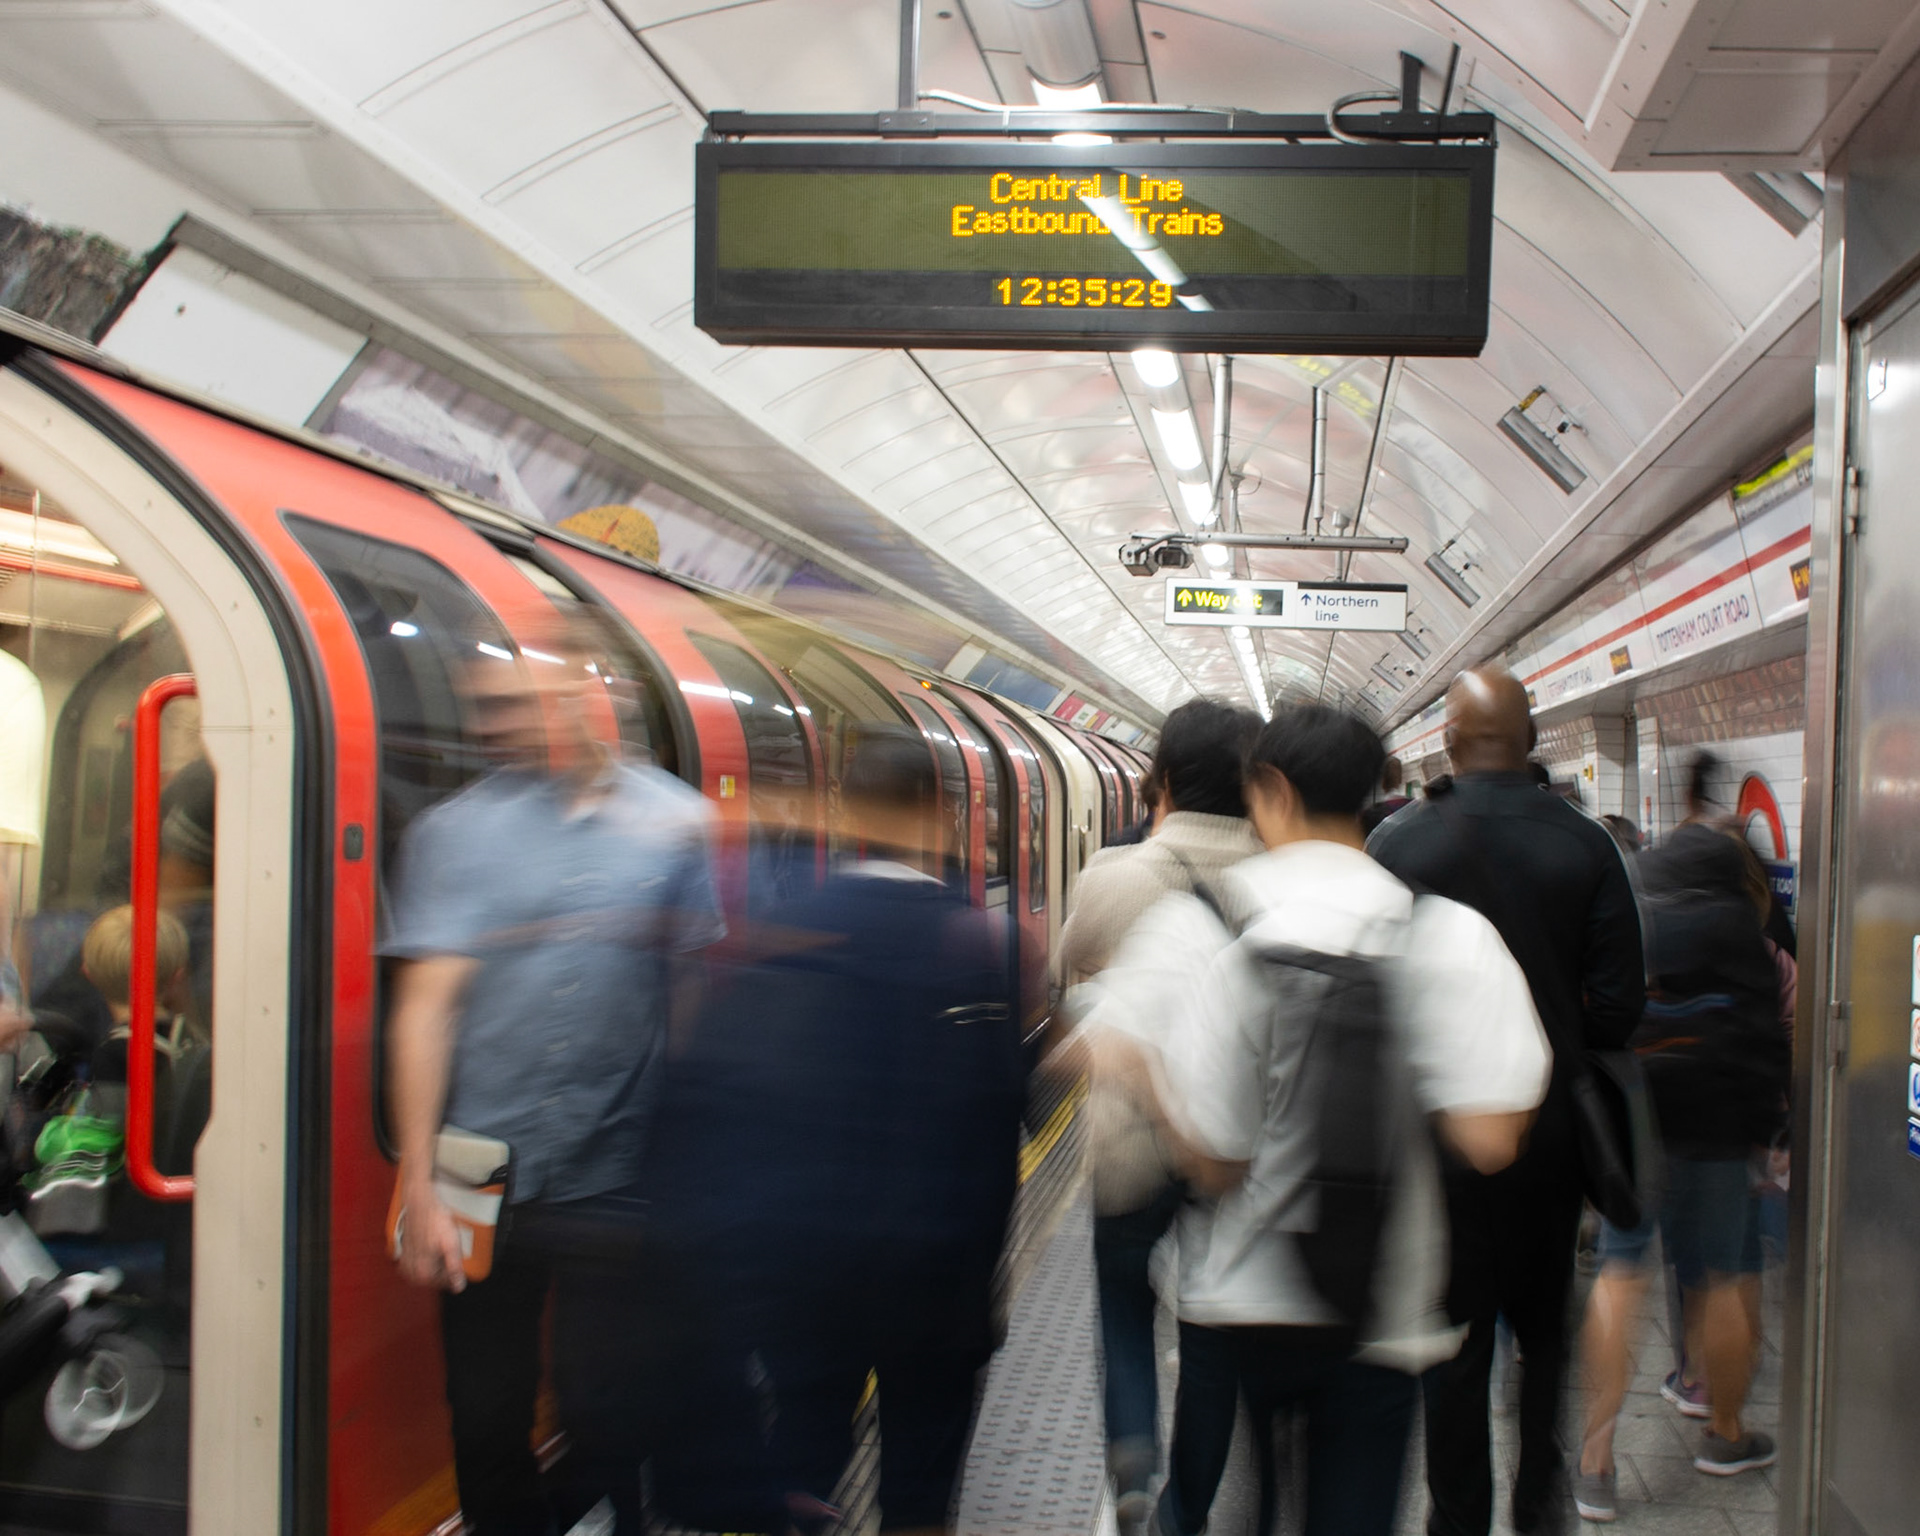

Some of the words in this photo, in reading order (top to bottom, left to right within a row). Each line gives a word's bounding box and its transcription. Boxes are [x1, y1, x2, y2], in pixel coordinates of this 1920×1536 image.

[990, 173, 1104, 203] Central
[1118, 173, 1184, 204] Line
[1124, 207, 1224, 236] Trains
[997, 277, 1172, 308] 12:35:29
[1194, 590, 1231, 611] Way
[1315, 594, 1379, 608] Northern
[1315, 610, 1340, 623] line
[1697, 604, 1724, 637] COURT
[1723, 594, 1750, 625] ROAD
